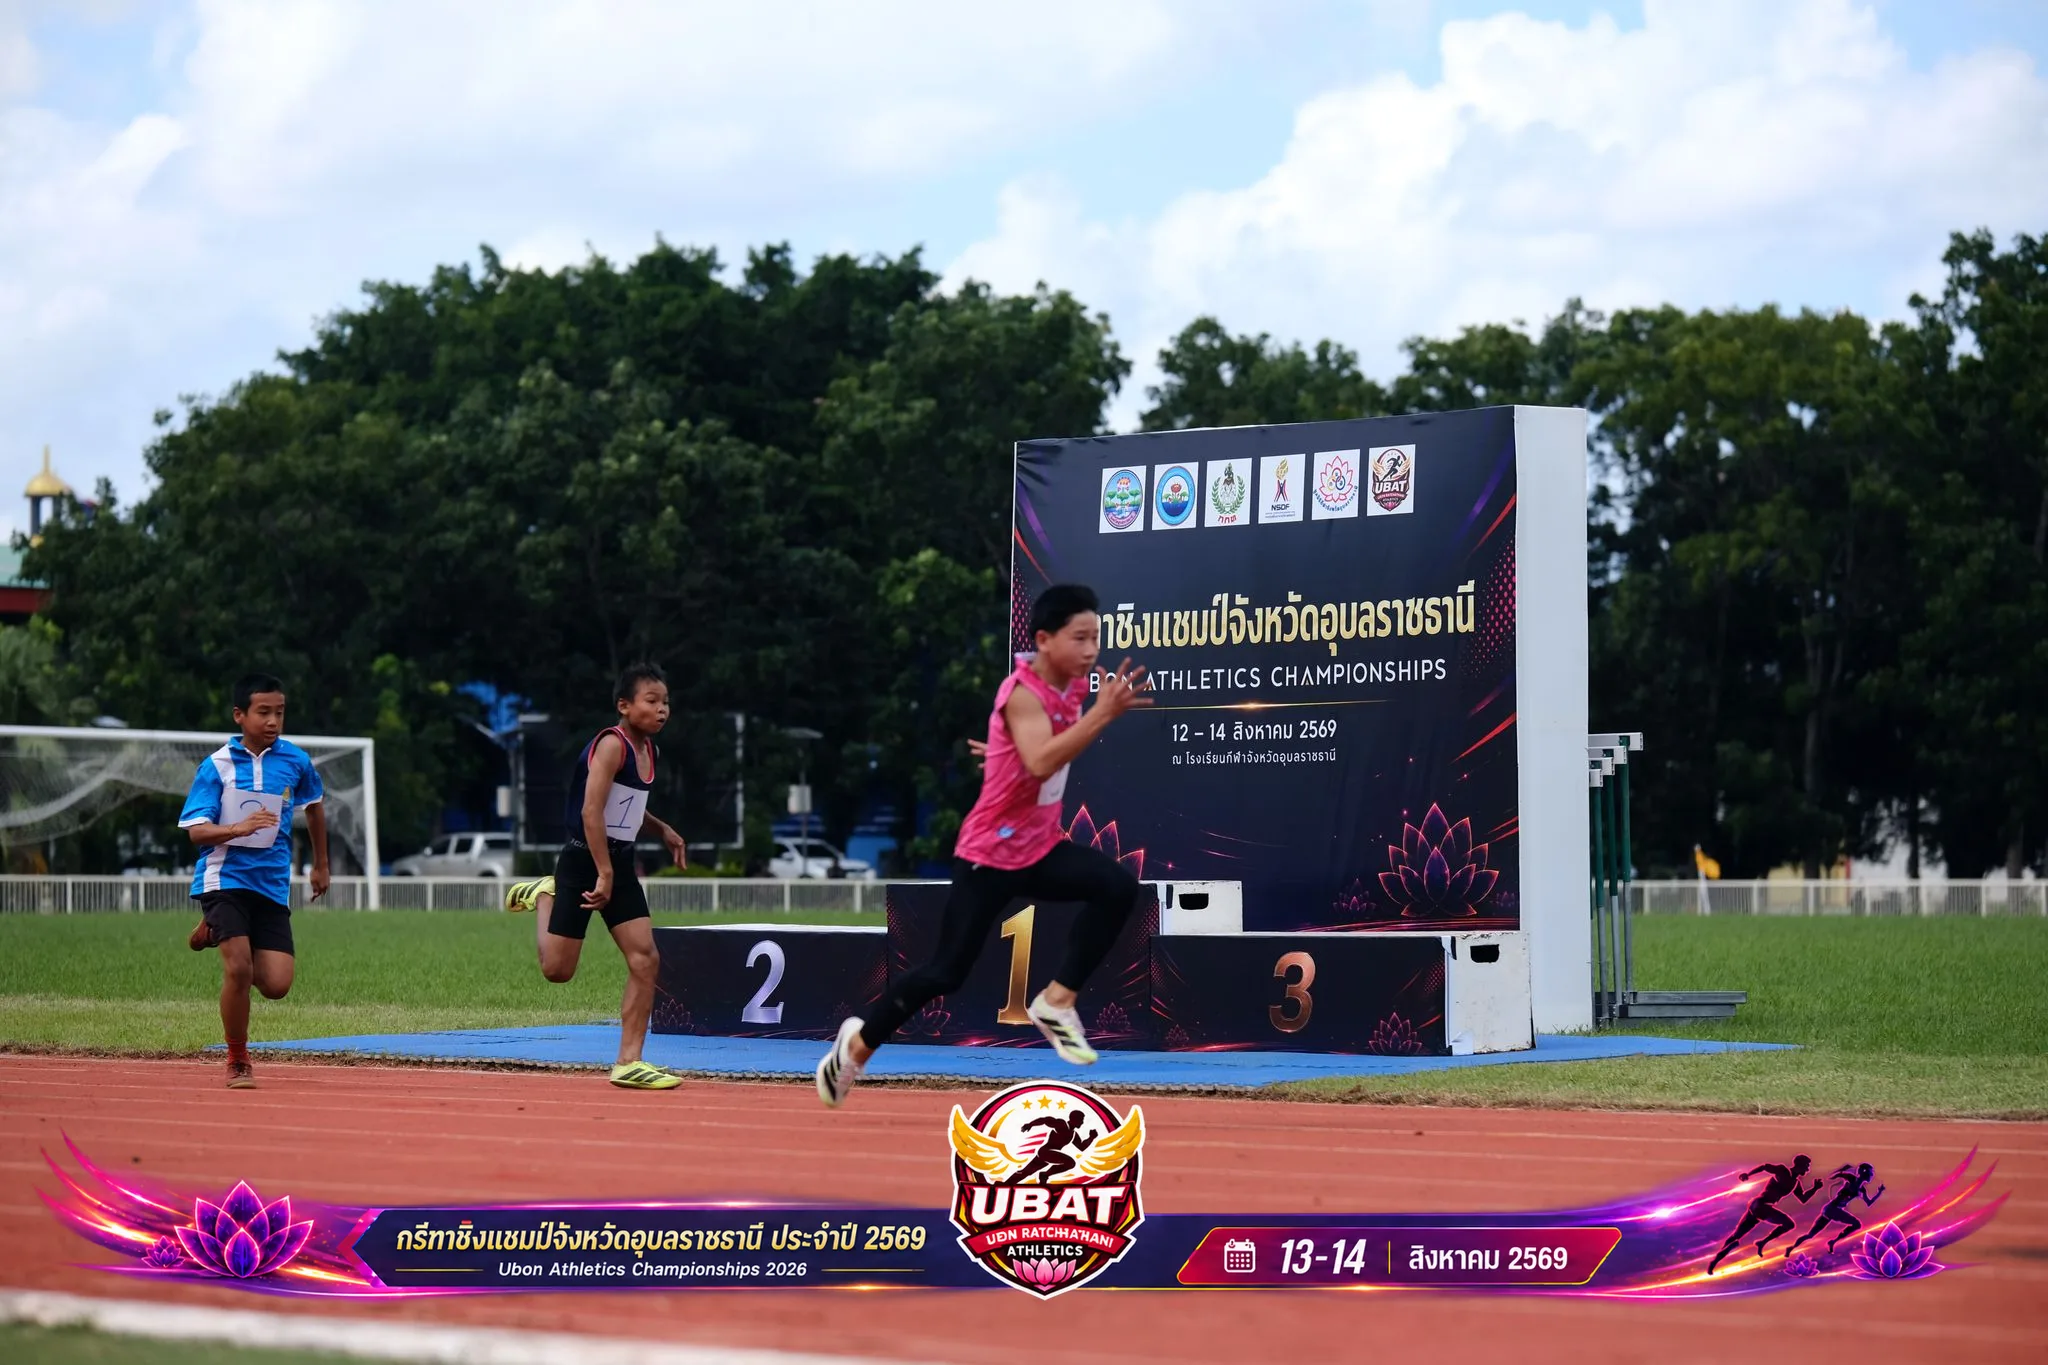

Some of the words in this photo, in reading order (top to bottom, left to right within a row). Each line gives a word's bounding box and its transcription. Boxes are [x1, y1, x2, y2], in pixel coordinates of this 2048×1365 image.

[1375, 480, 1407, 494] UBAT
[1097, 579, 1475, 656] าชิงแชมป์จังหวัดอุบลราชธานี
[1143, 667, 1261, 692] ATHLETICS
[1271, 658, 1447, 687] CHAMPIONSHIPS
[1172, 723, 1189, 742] 12
[1209, 722, 1226, 741] 14
[1233, 721, 1293, 741] สิงหาคม
[1299, 719, 1337, 739] 2569
[1172, 755, 1182, 765] ณ
[1186, 748, 1337, 766] โรงเรียนกีฬาจังหวัดอุบลราชธานี
[606, 795, 634, 829] 1
[741, 939, 786, 1025] 2
[997, 904, 1036, 1026] 1
[1269, 950, 1316, 1033] 3
